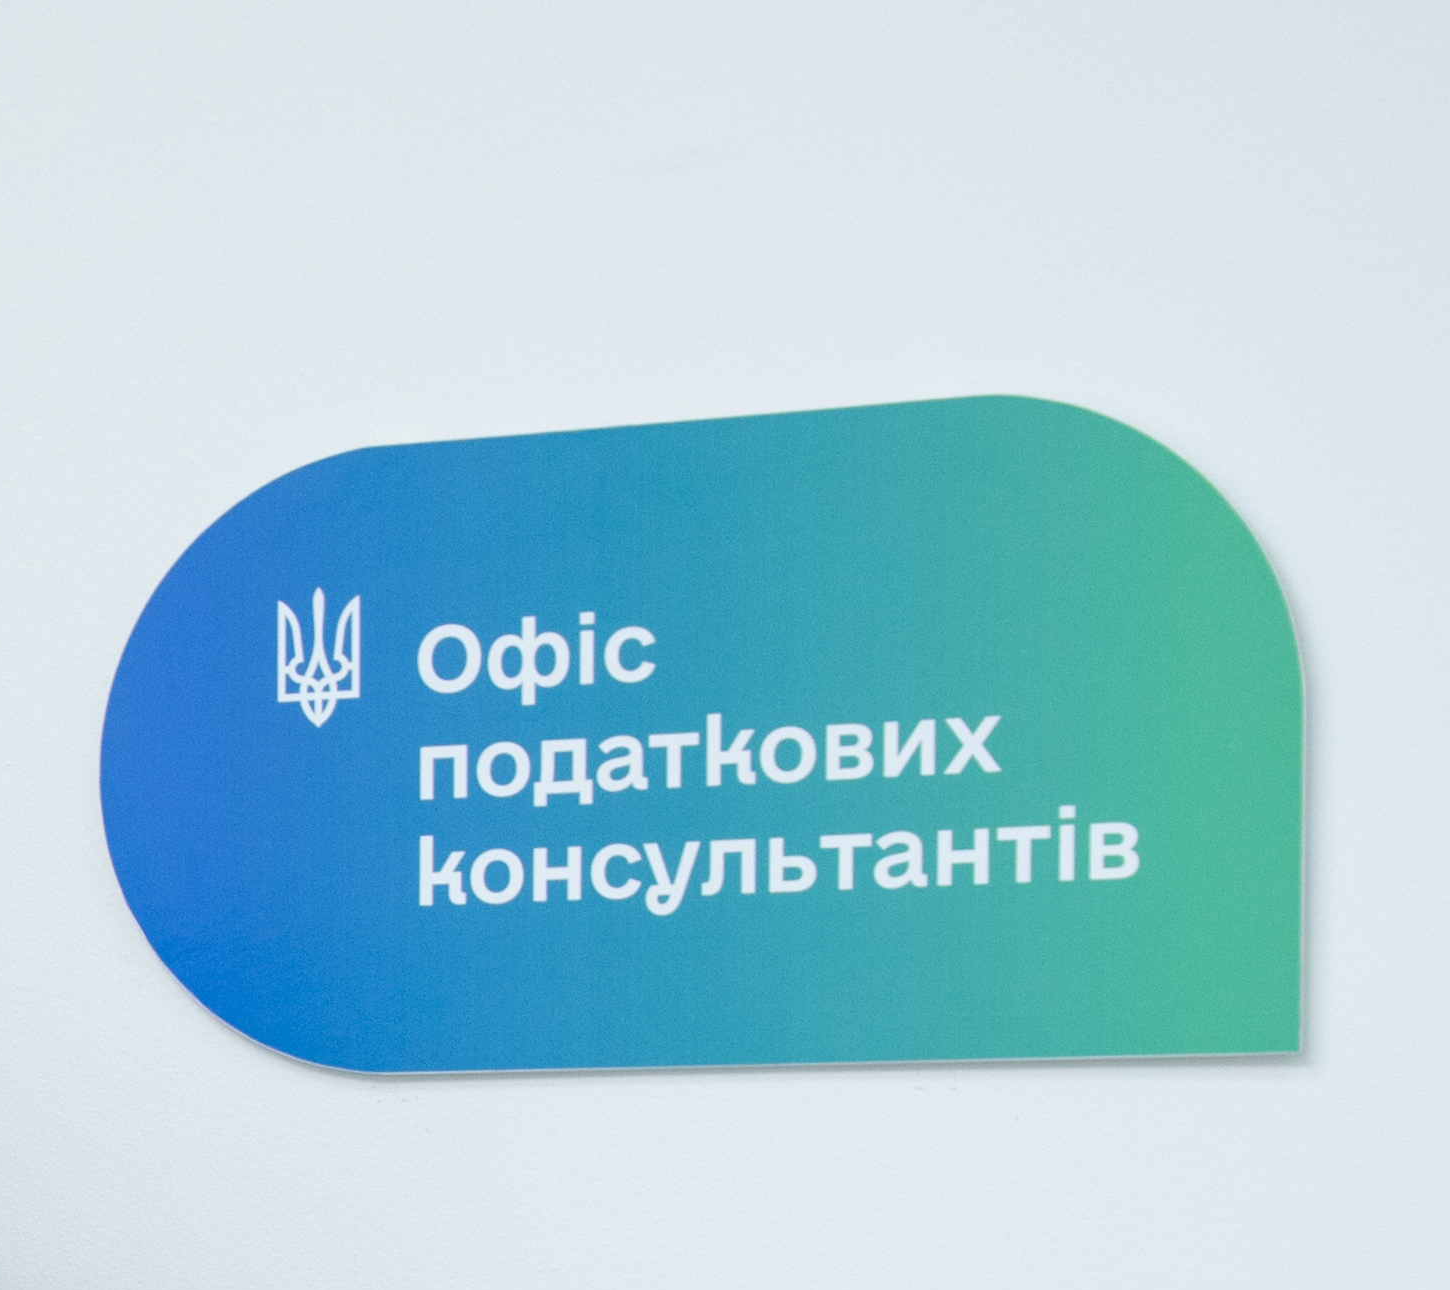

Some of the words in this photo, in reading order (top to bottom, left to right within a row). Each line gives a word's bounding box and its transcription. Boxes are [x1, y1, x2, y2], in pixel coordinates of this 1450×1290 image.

[415, 610, 657, 706] Офіс
[417, 712, 1003, 807] податкових
[417, 805, 1142, 916] консультантів
